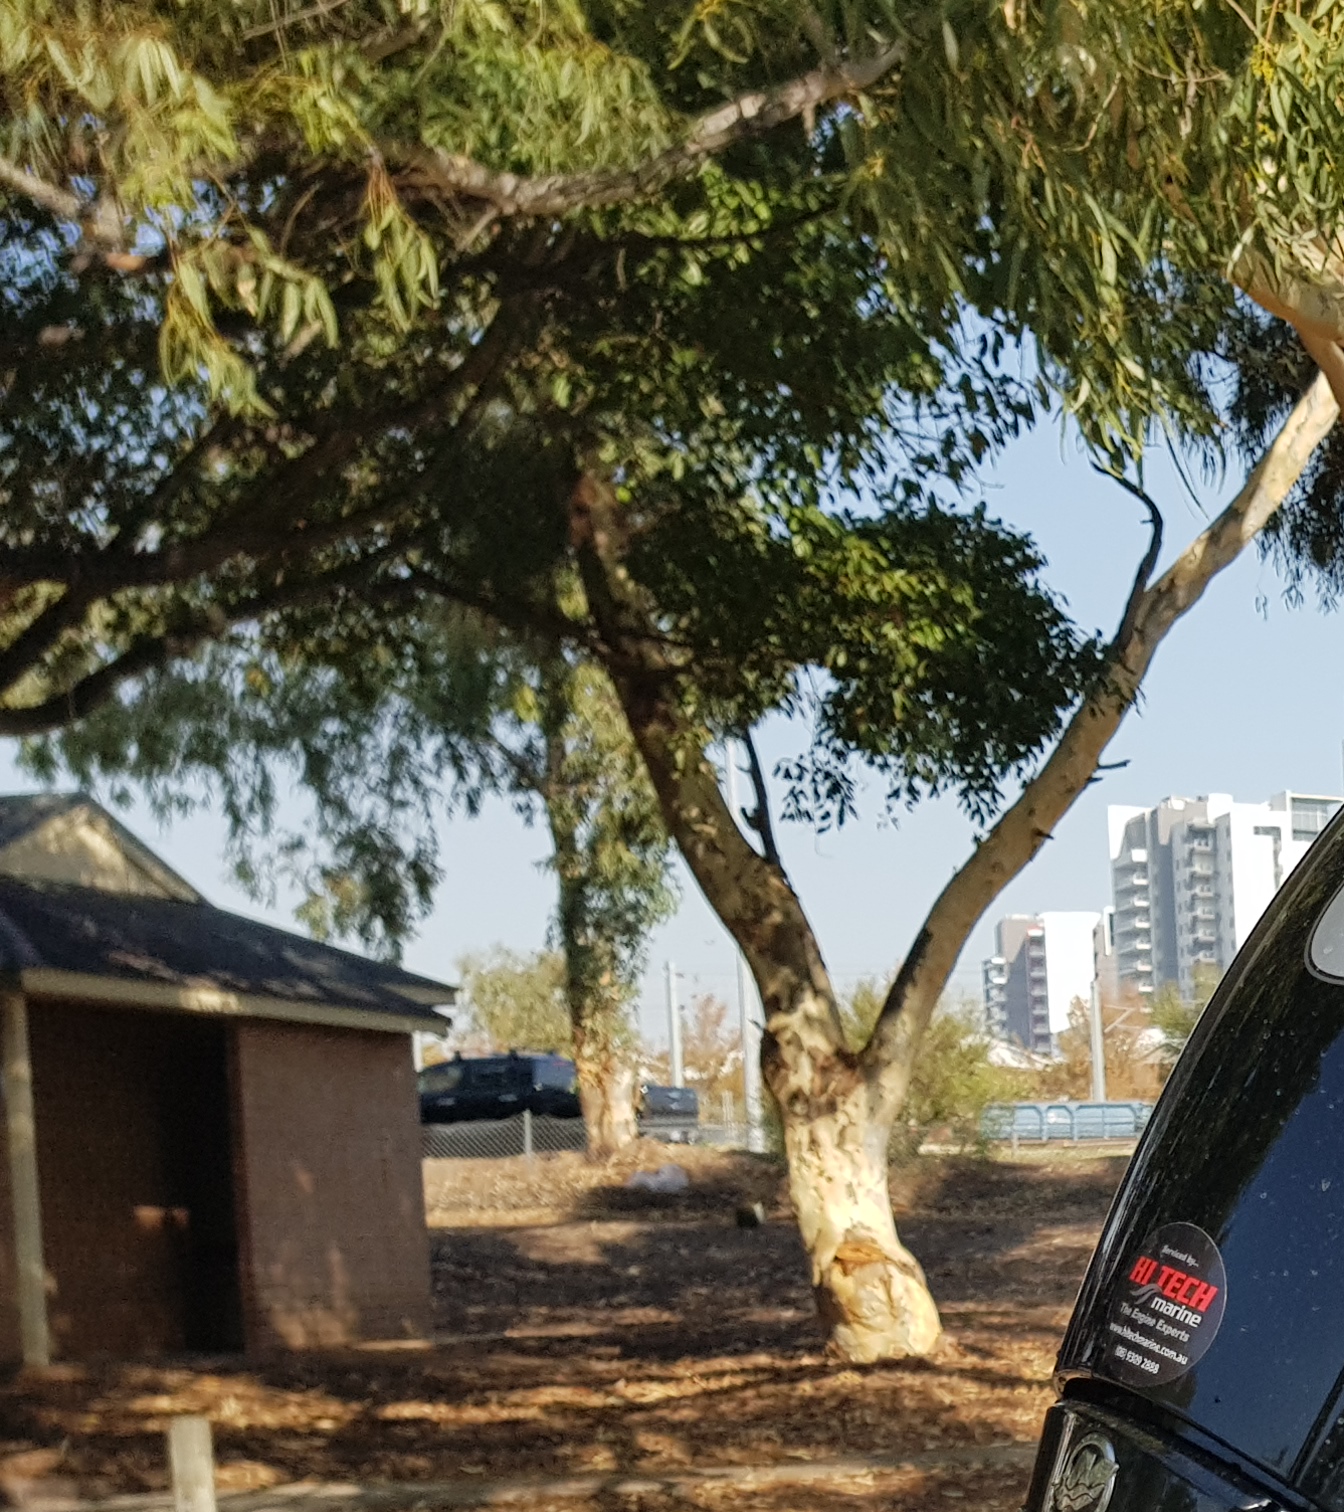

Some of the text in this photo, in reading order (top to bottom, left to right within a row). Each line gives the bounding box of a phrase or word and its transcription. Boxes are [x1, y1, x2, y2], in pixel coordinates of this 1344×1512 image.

[1129, 1255, 1219, 1313] HI TECH
[1120, 1301, 1190, 1342] The Engine Experts
[1150, 1297, 1202, 1328] marine
